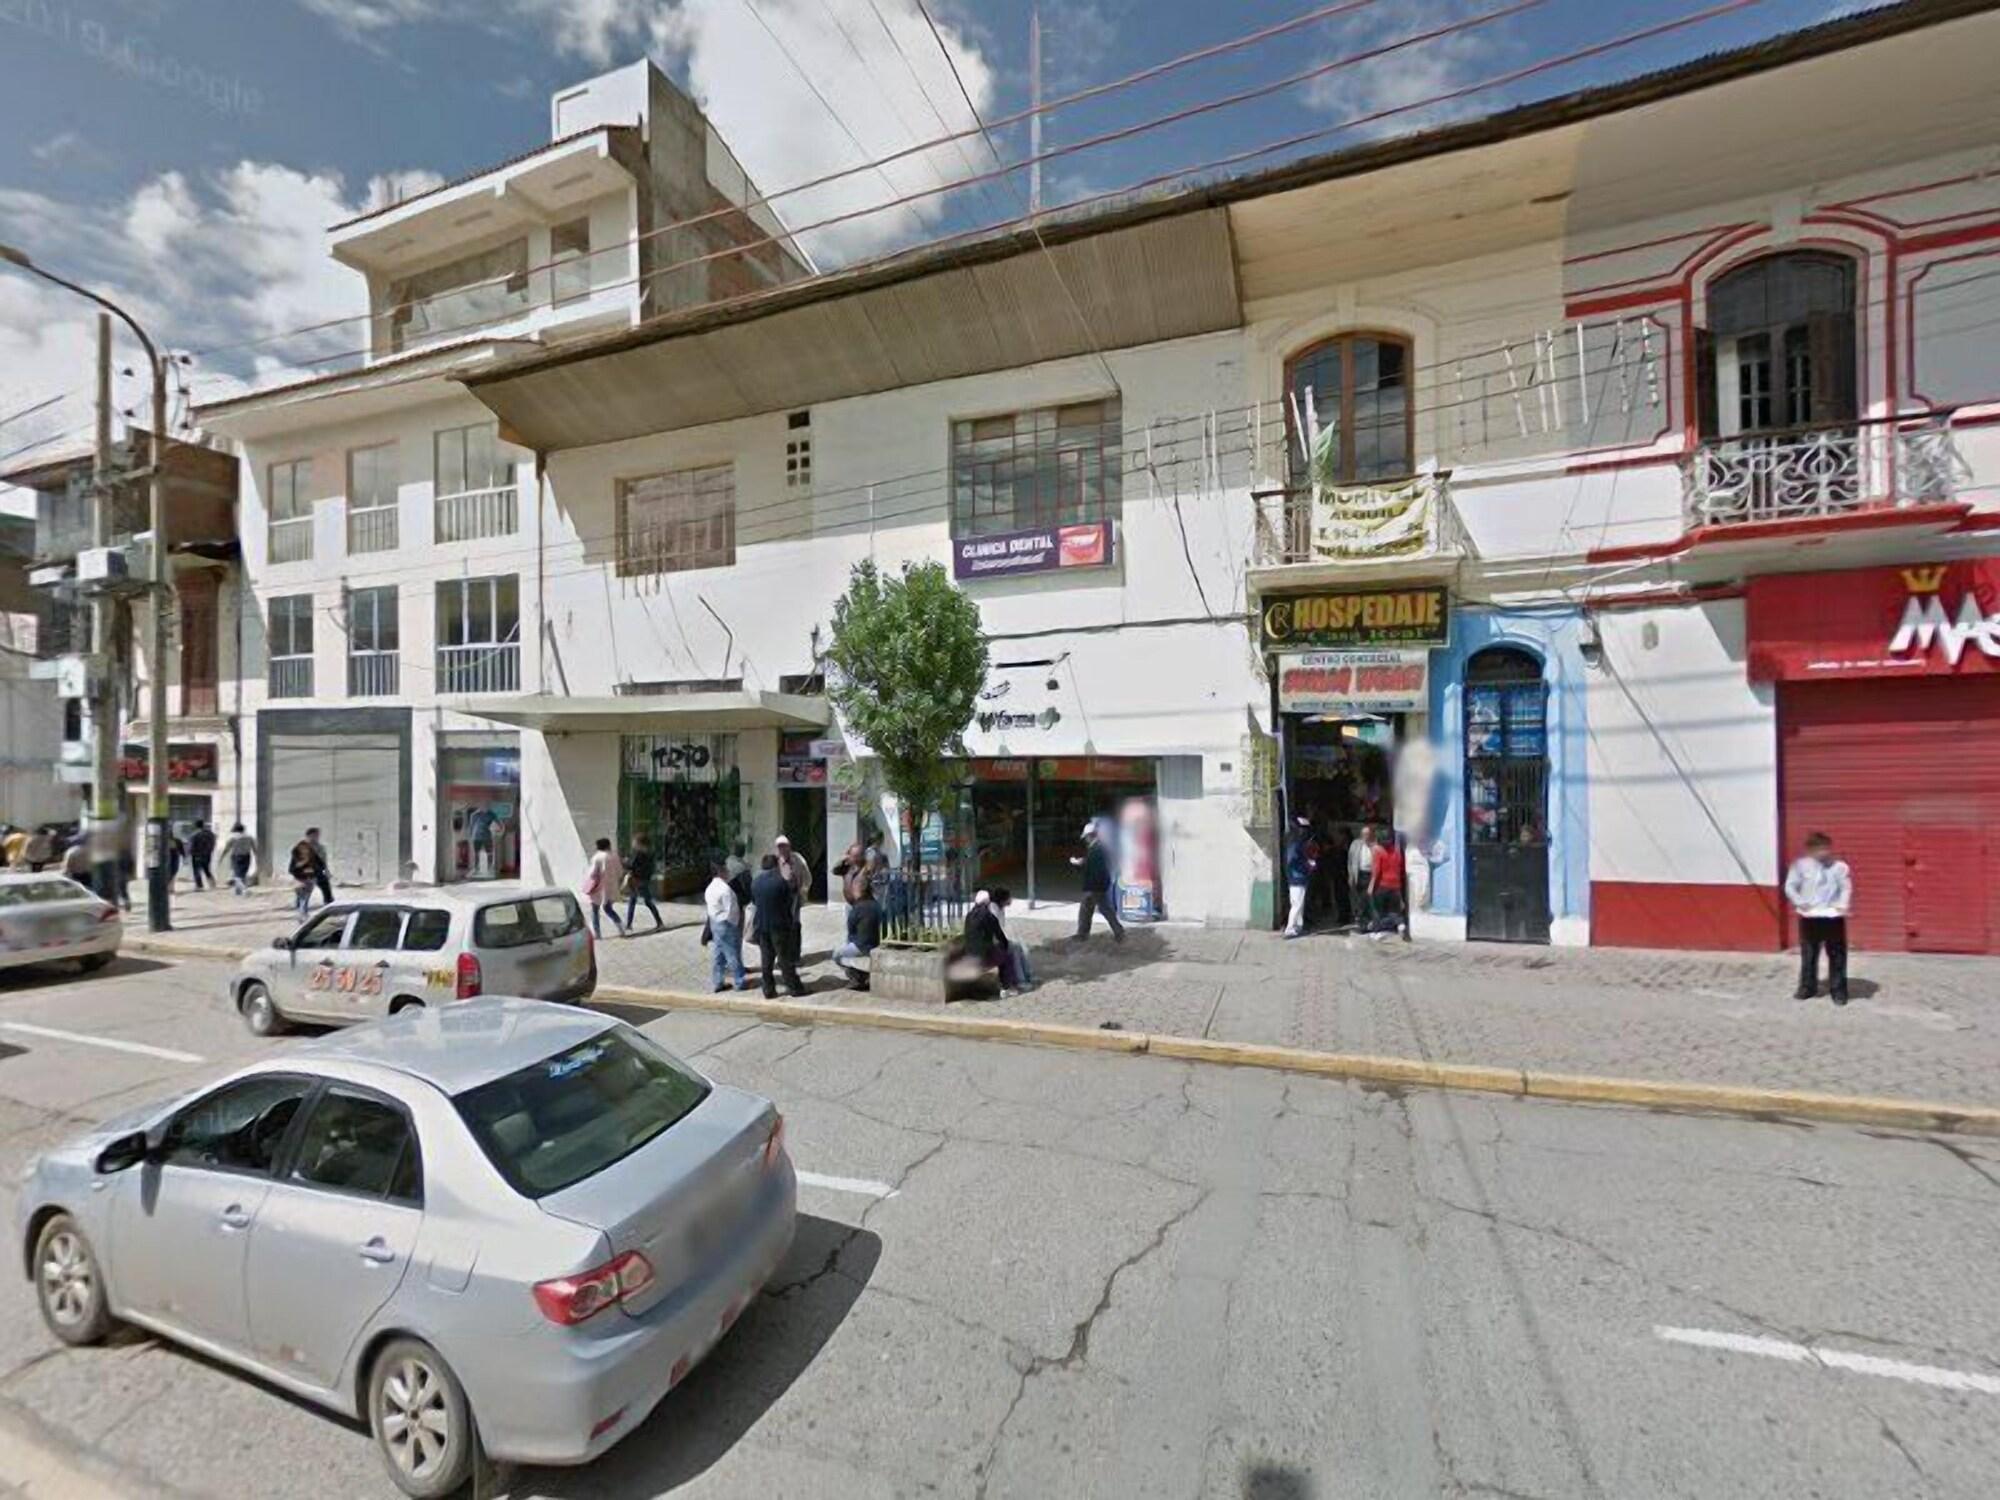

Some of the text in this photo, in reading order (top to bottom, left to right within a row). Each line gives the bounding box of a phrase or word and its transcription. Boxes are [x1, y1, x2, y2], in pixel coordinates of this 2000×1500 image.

[1294, 591, 1441, 631] HOSPEDAJE
[1302, 652, 1401, 666] CENTRO COMERCIAL
